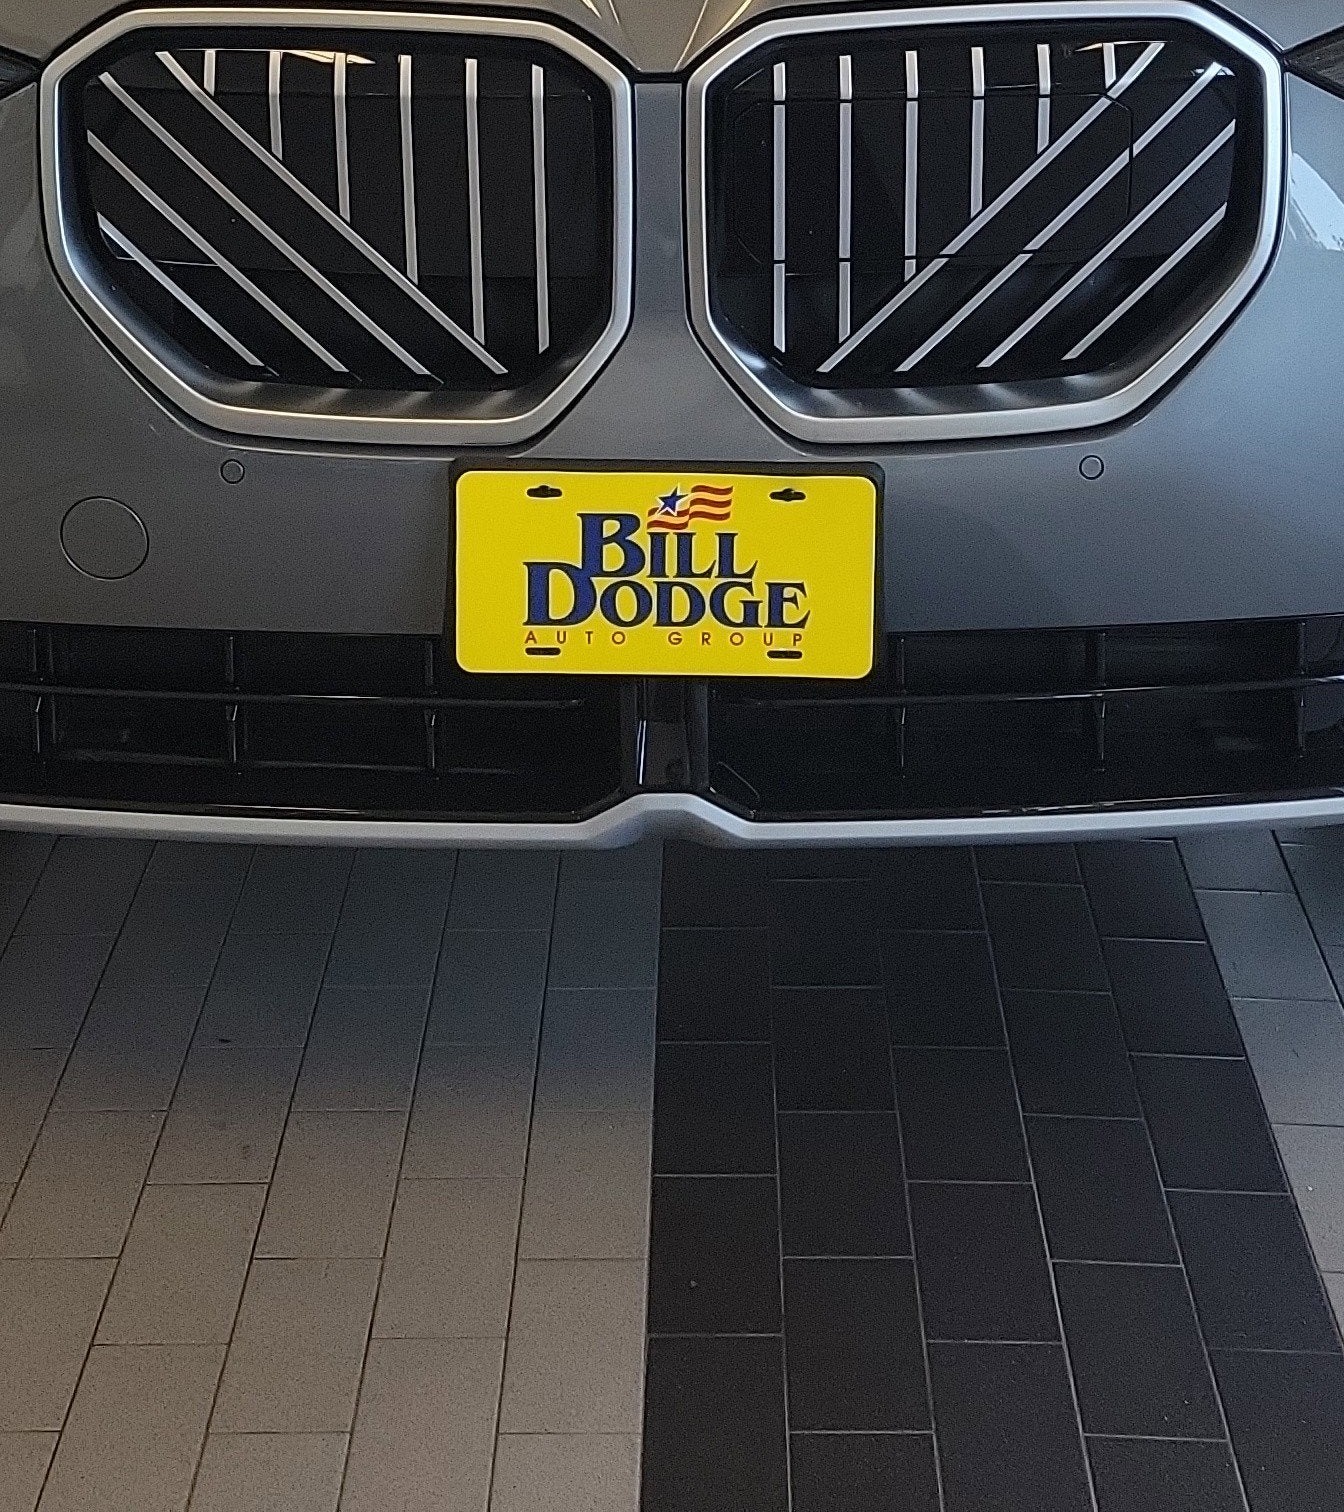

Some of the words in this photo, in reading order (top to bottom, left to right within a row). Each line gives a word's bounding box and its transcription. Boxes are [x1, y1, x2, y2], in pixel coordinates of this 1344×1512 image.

[576, 512, 758, 580] BILL
[522, 561, 812, 629] DODGE
[524, 631, 627, 646] AUTO
[667, 632, 803, 647] GROUP
